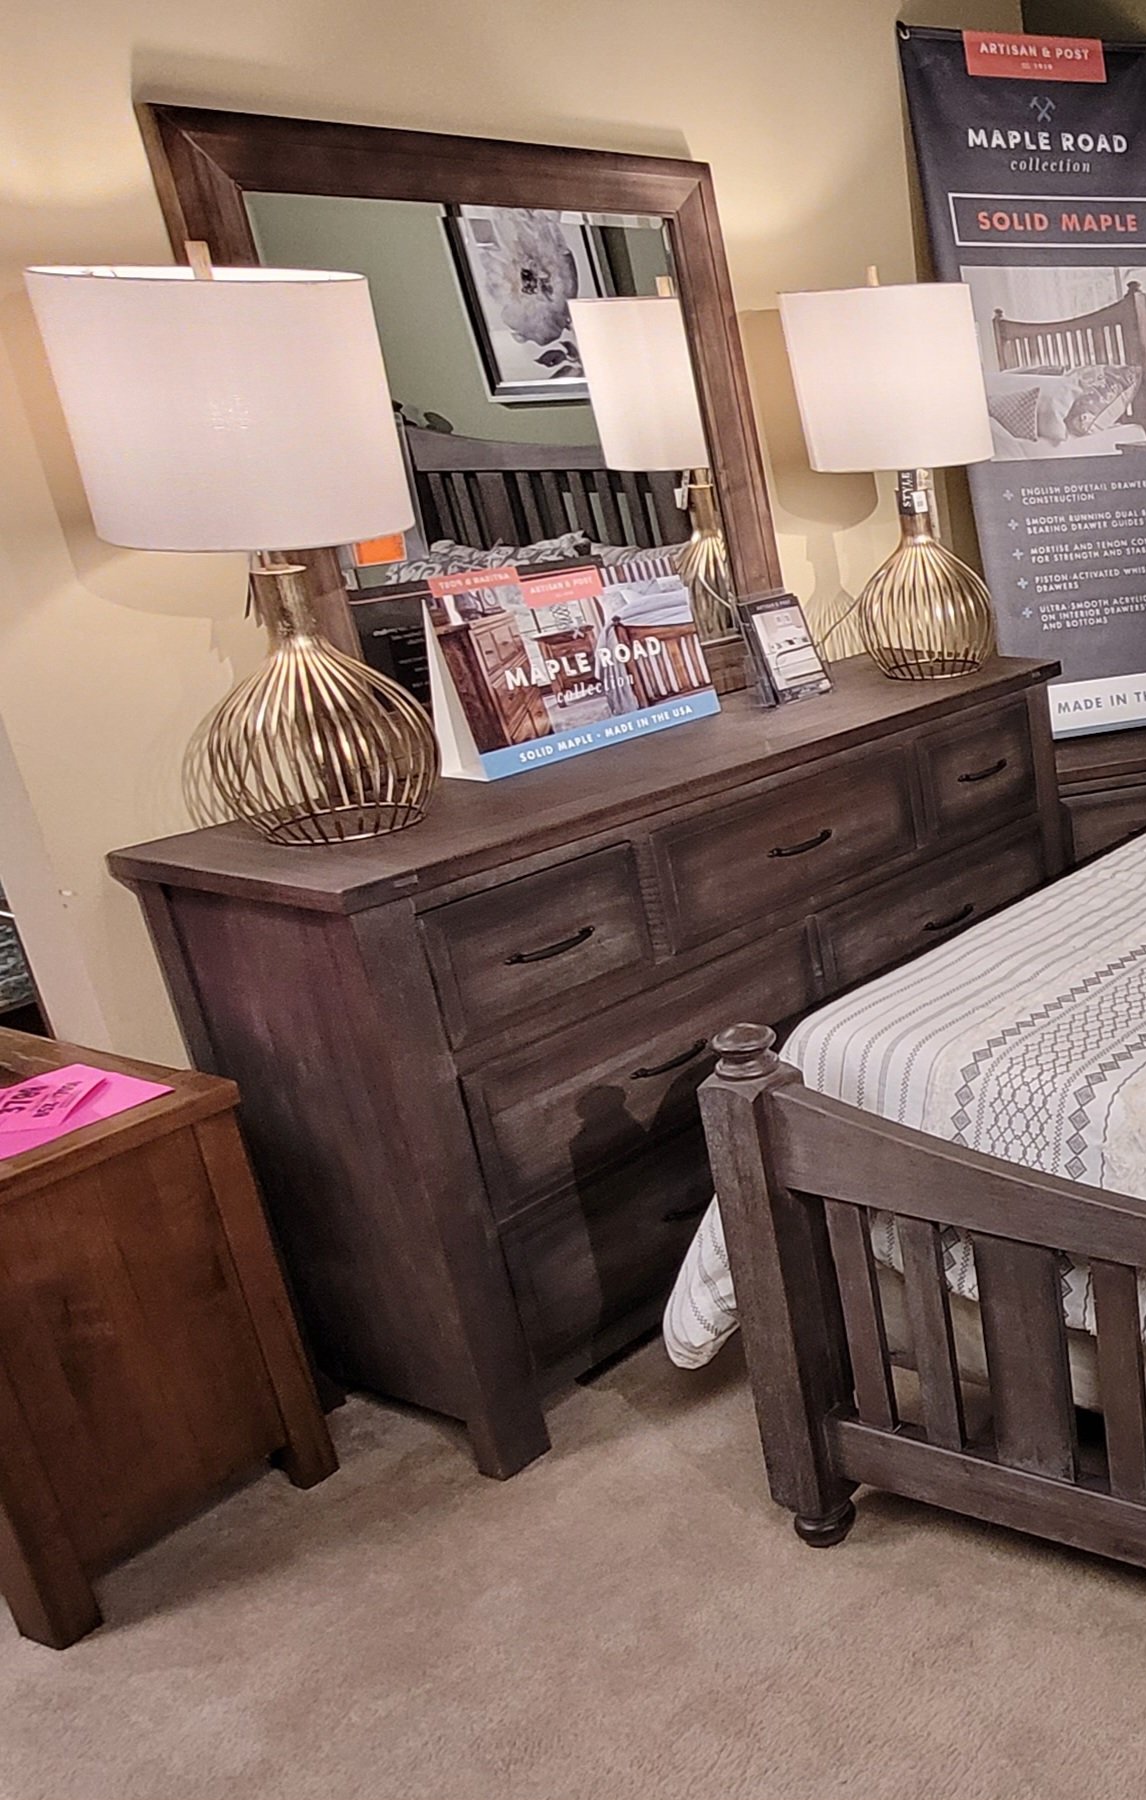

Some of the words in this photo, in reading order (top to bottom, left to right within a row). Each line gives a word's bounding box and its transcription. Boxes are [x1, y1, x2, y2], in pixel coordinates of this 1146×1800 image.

[980, 43, 1037, 58] ARTISAN
[1042, 46, 1051, 58] &
[1056, 48, 1089, 60] POST
[968, 128, 1051, 150] MAPLE
[1061, 133, 1128, 153] ROAD
[1010, 157, 1091, 173] collection
[978, 212, 1049, 231] SOLID
[1061, 213, 1138, 232] MAPLE
[1021, 486, 1060, 496] ENGLISH
[1064, 483, 1108, 494] DOVETAIL
[1111, 480, 1146, 490] DRAWER
[1022, 493, 1094, 505] CONSTRUCTION
[1026, 515, 1065, 526] SMOOTH
[1069, 512, 1112, 522] RUNNING
[1115, 509, 1138, 519] DUAL
[1027, 524, 1068, 534] BEARING
[1071, 520, 1108, 532] DRAWER
[1112, 518, 1144, 528] GUIDES
[1030, 544, 1069, 555] MORTISE
[1073, 541, 1092, 550] AND
[1096, 539, 1128, 548] TENON
[1032, 554, 1050, 564] FOR
[1053, 550, 1100, 562] STRENGTH
[1103, 548, 1122, 558] AND
[1035, 568, 1120, 584] PISTON-ACTIVATED
[530, 582, 564, 594] ARTISAN
[573, 577, 593, 587] POST
[1036, 582, 1079, 593] DRAWERS
[1039, 600, 1108, 613] ULTRA-SMOOTH
[1041, 612, 1056, 622] ON
[1060, 609, 1100, 620] INTERIOR
[1042, 620, 1062, 631] AND
[1066, 616, 1108, 628] BOTTOMS
[505, 653, 591, 691] MAPLE
[599, 636, 663, 667] ROAD
[557, 673, 635, 704] collection
[1057, 698, 1103, 714] MADE
[1110, 692, 1127, 706] IN
[520, 745, 553, 763] SOLID
[558, 733, 593, 751] MAPLE
[605, 722, 635, 739] MADE
[637, 718, 649, 729] IN
[651, 712, 670, 725] THE
[673, 705, 693, 718] USA
